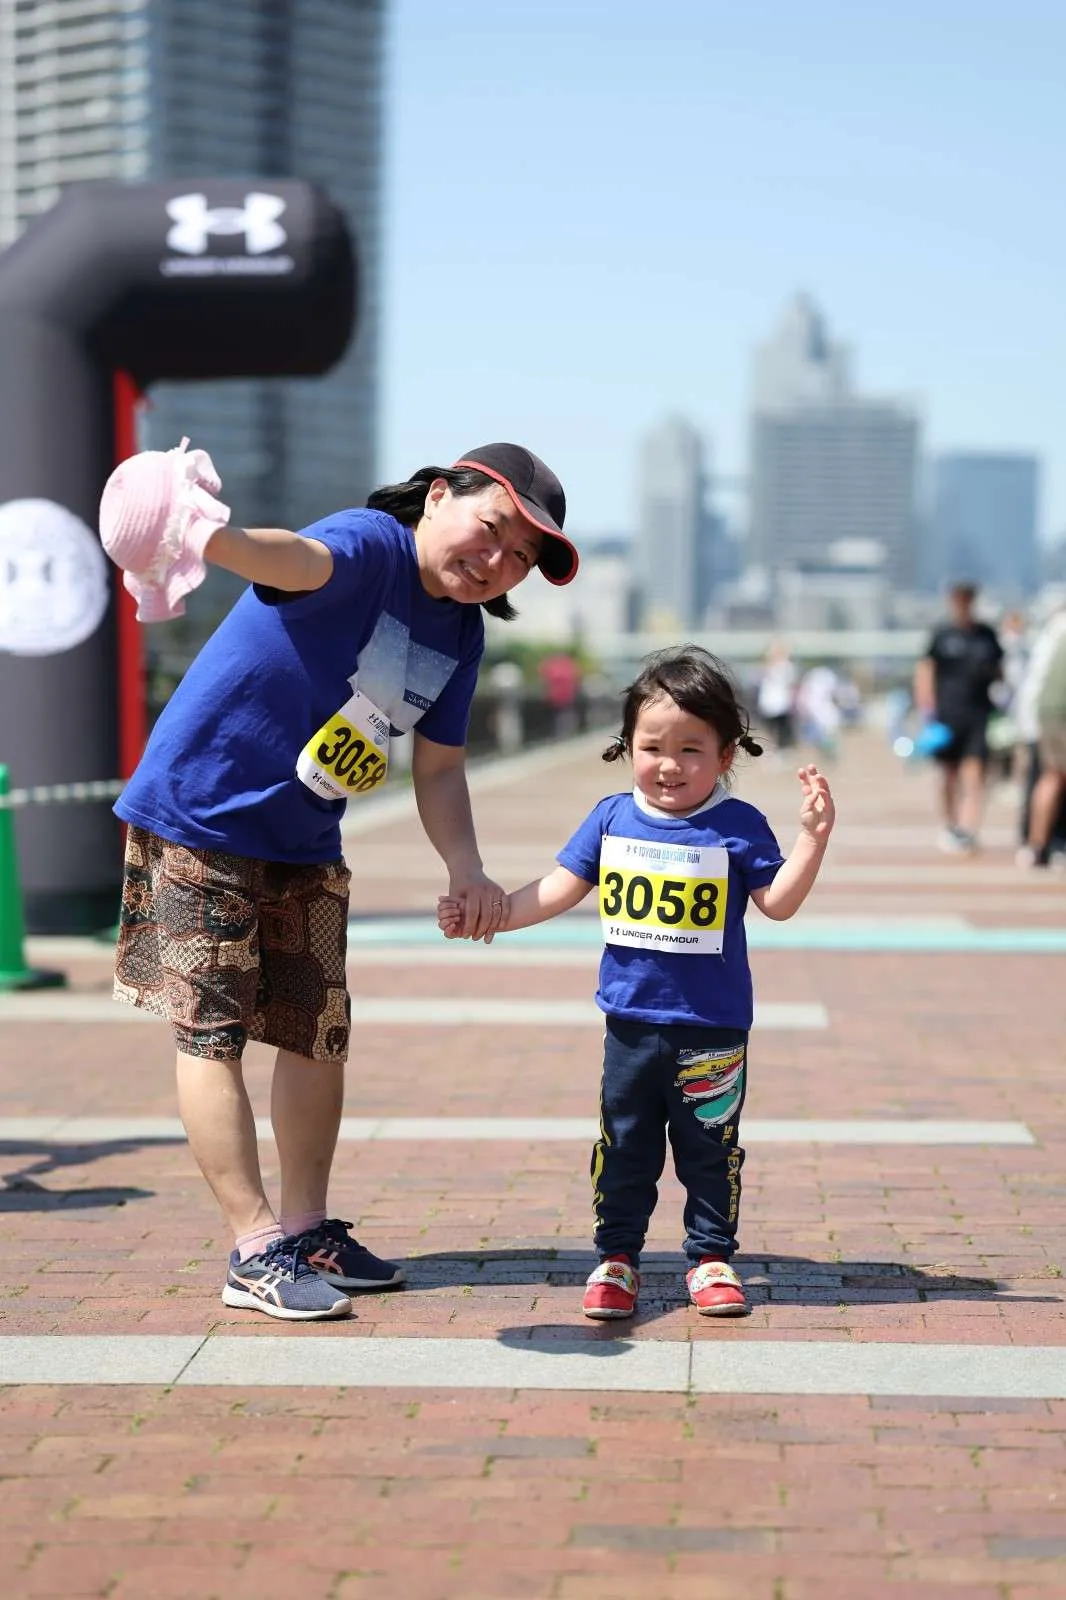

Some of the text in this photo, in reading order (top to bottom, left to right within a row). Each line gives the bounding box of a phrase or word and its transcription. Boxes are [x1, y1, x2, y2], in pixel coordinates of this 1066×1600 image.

[317, 727, 386, 792] 3058
[687, 852, 701, 864] RUN
[603, 871, 719, 927] 3058
[622, 929, 699, 944] UNDER ARMOUR
[727, 1156, 740, 1224] EXPRESS
